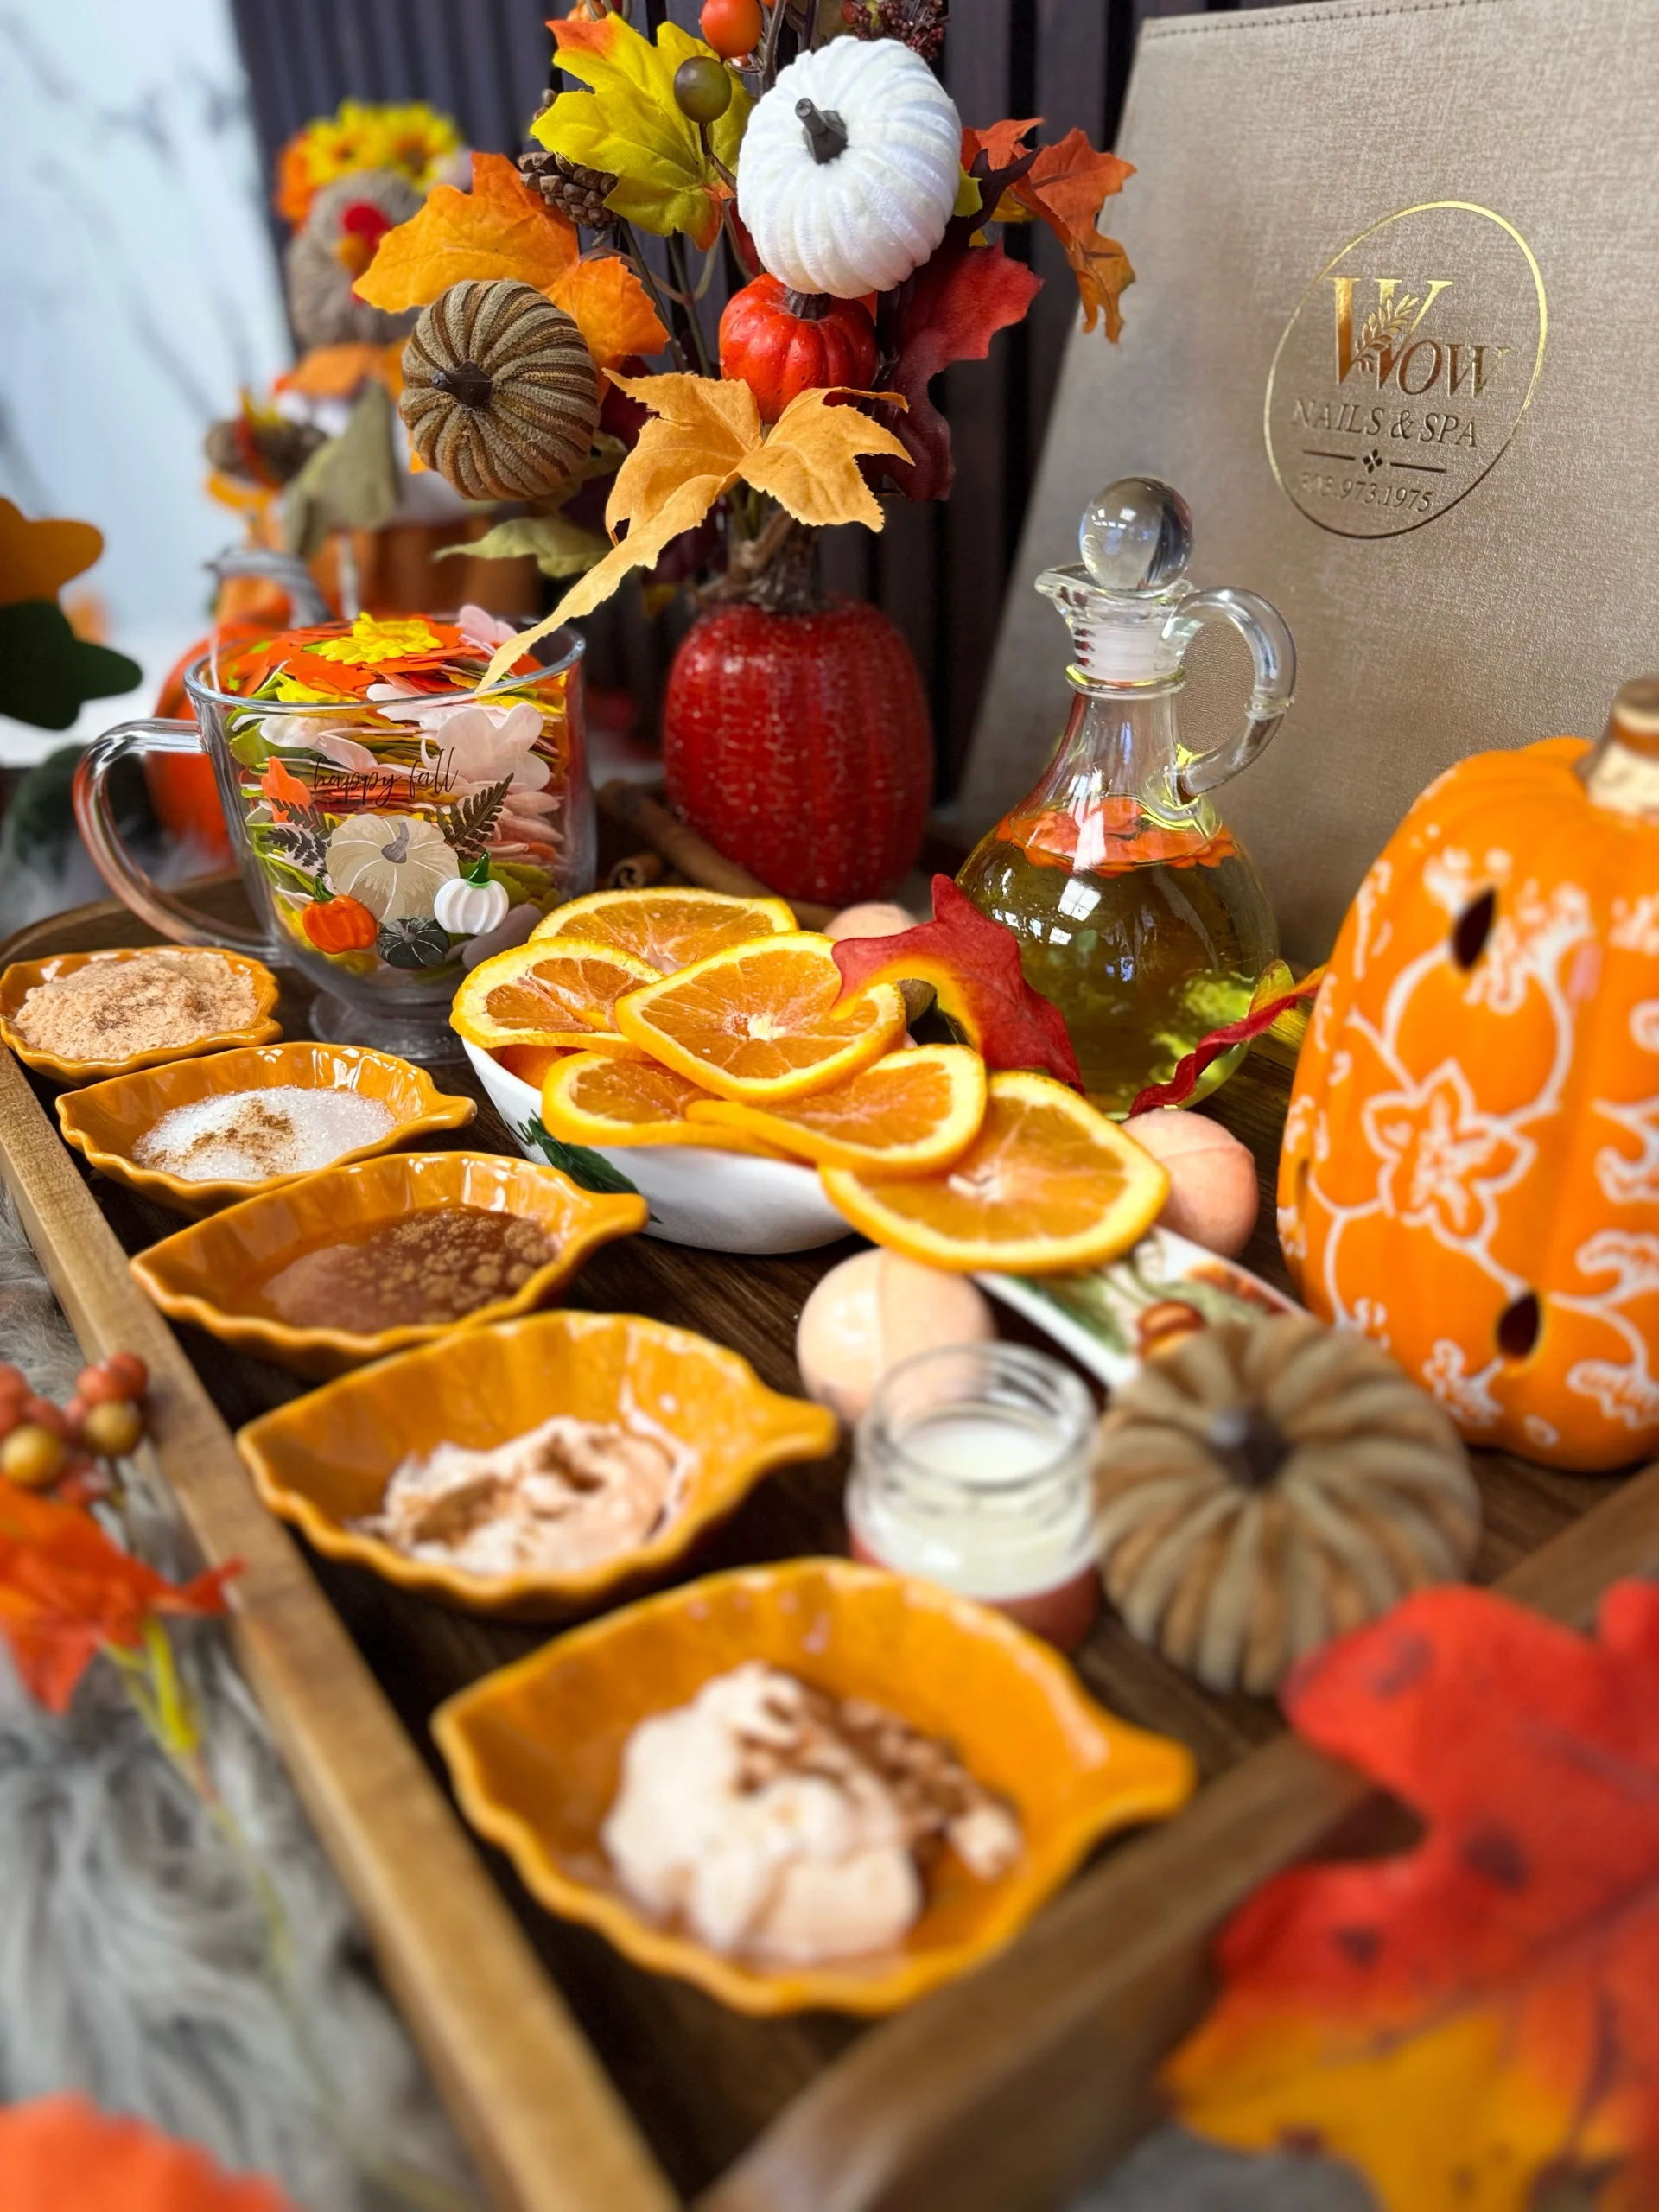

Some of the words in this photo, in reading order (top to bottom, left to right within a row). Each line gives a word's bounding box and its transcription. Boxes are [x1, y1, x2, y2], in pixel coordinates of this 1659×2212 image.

[1326, 276, 1511, 399] WOW
[1291, 397, 1386, 436] NAILS
[1389, 409, 1415, 440] &
[1419, 411, 1479, 448] SPA
[313, 756, 403, 807] happy
[408, 747, 460, 799] fall
